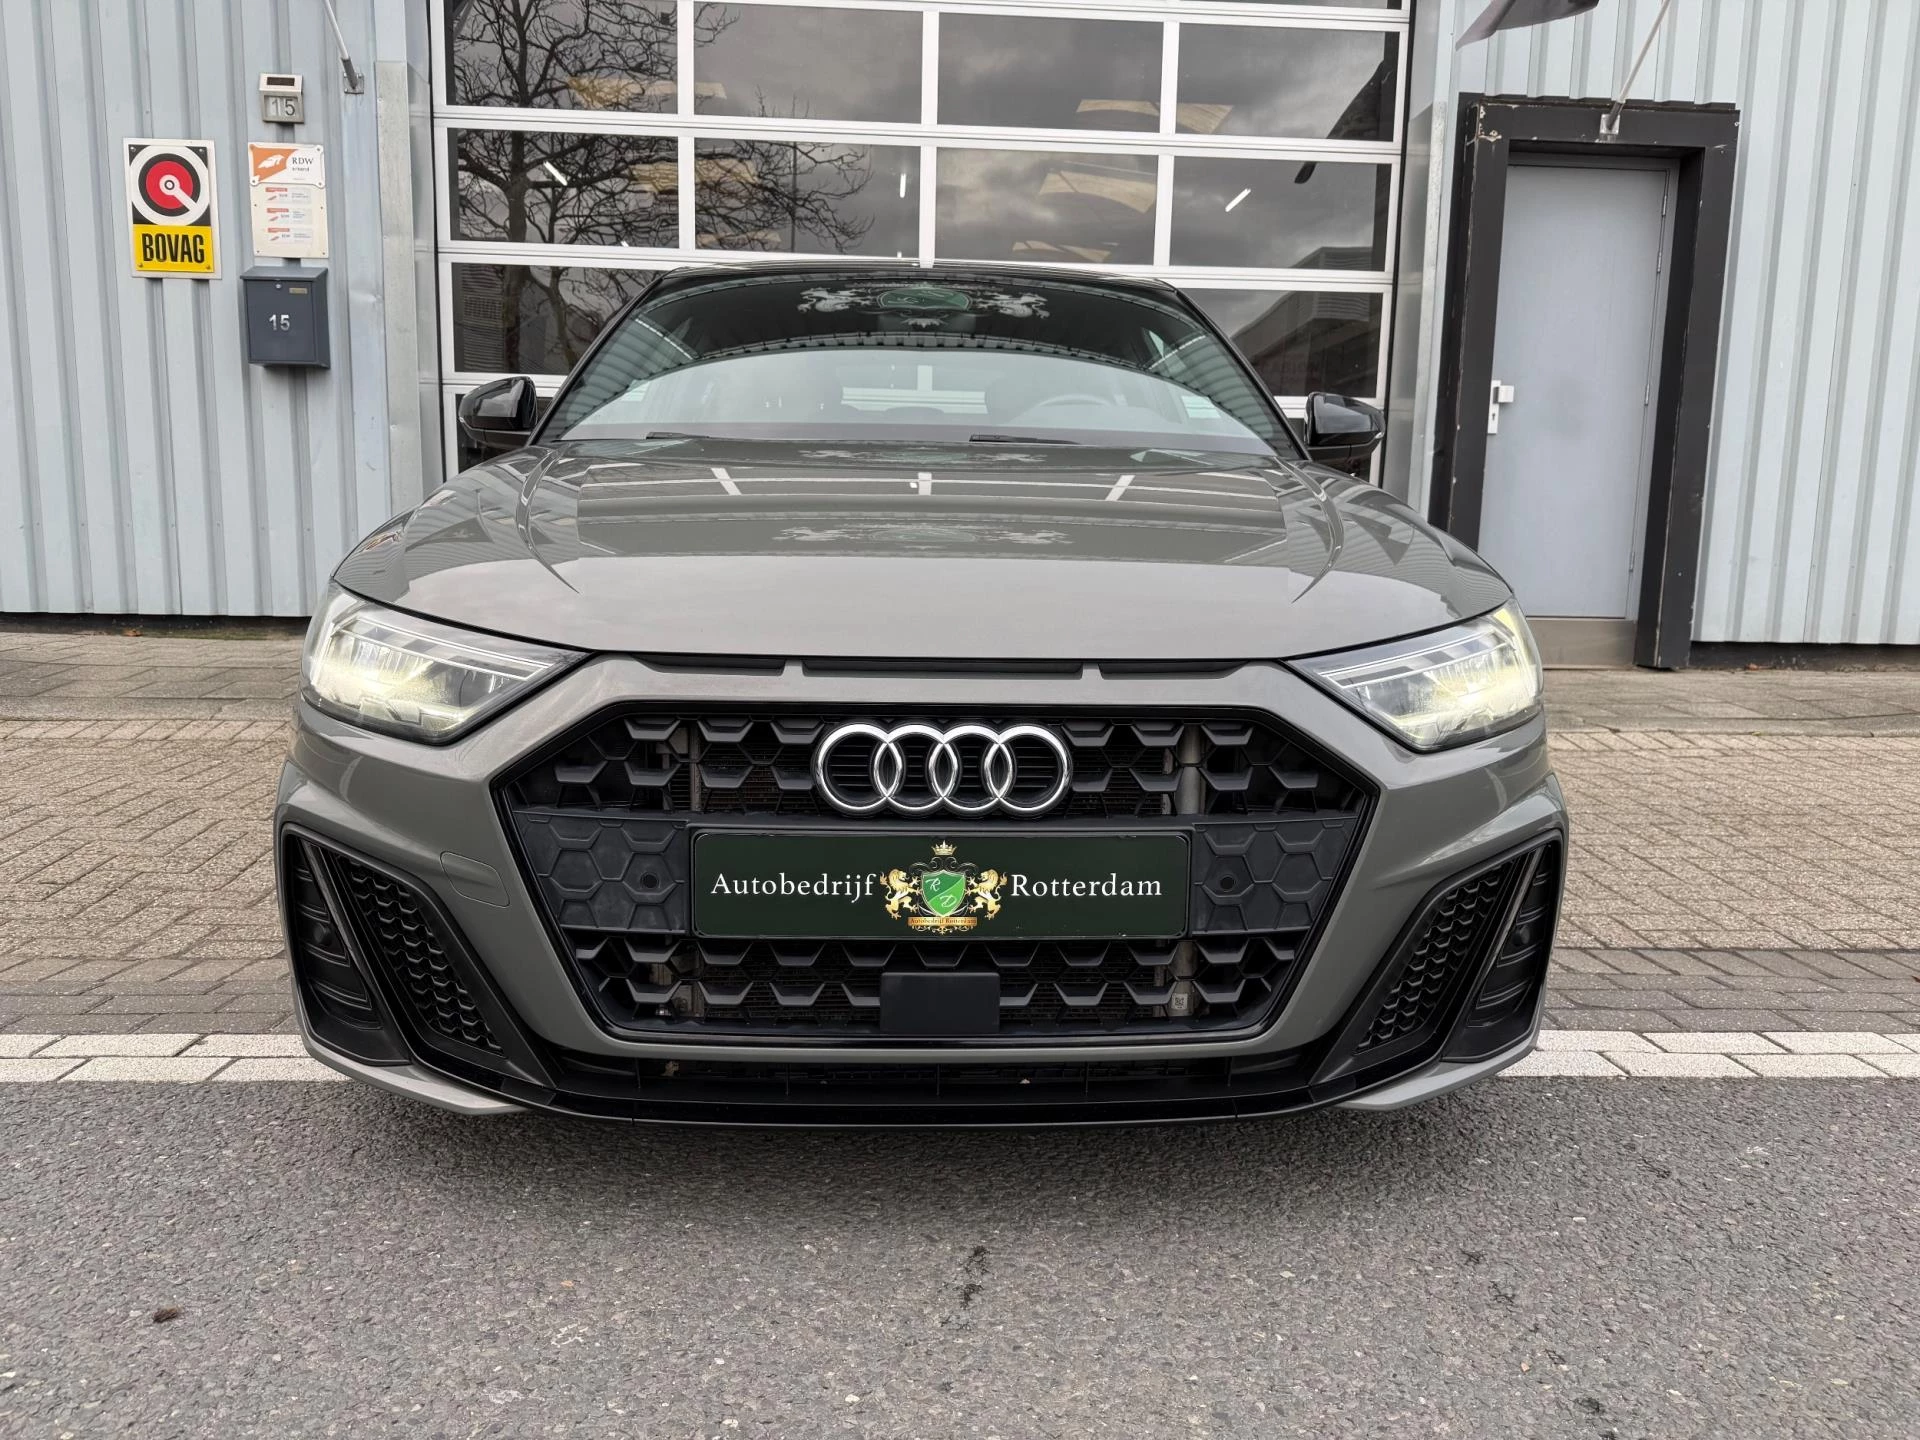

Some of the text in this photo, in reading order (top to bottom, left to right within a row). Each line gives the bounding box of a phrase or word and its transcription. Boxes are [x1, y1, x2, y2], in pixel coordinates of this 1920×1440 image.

[271, 98, 296, 116] 15
[291, 157, 314, 165] RDW
[141, 232, 205, 264] BOVAG
[268, 314, 291, 331] 15
[711, 872, 1162, 904] Autobedrijf Rotterdam
